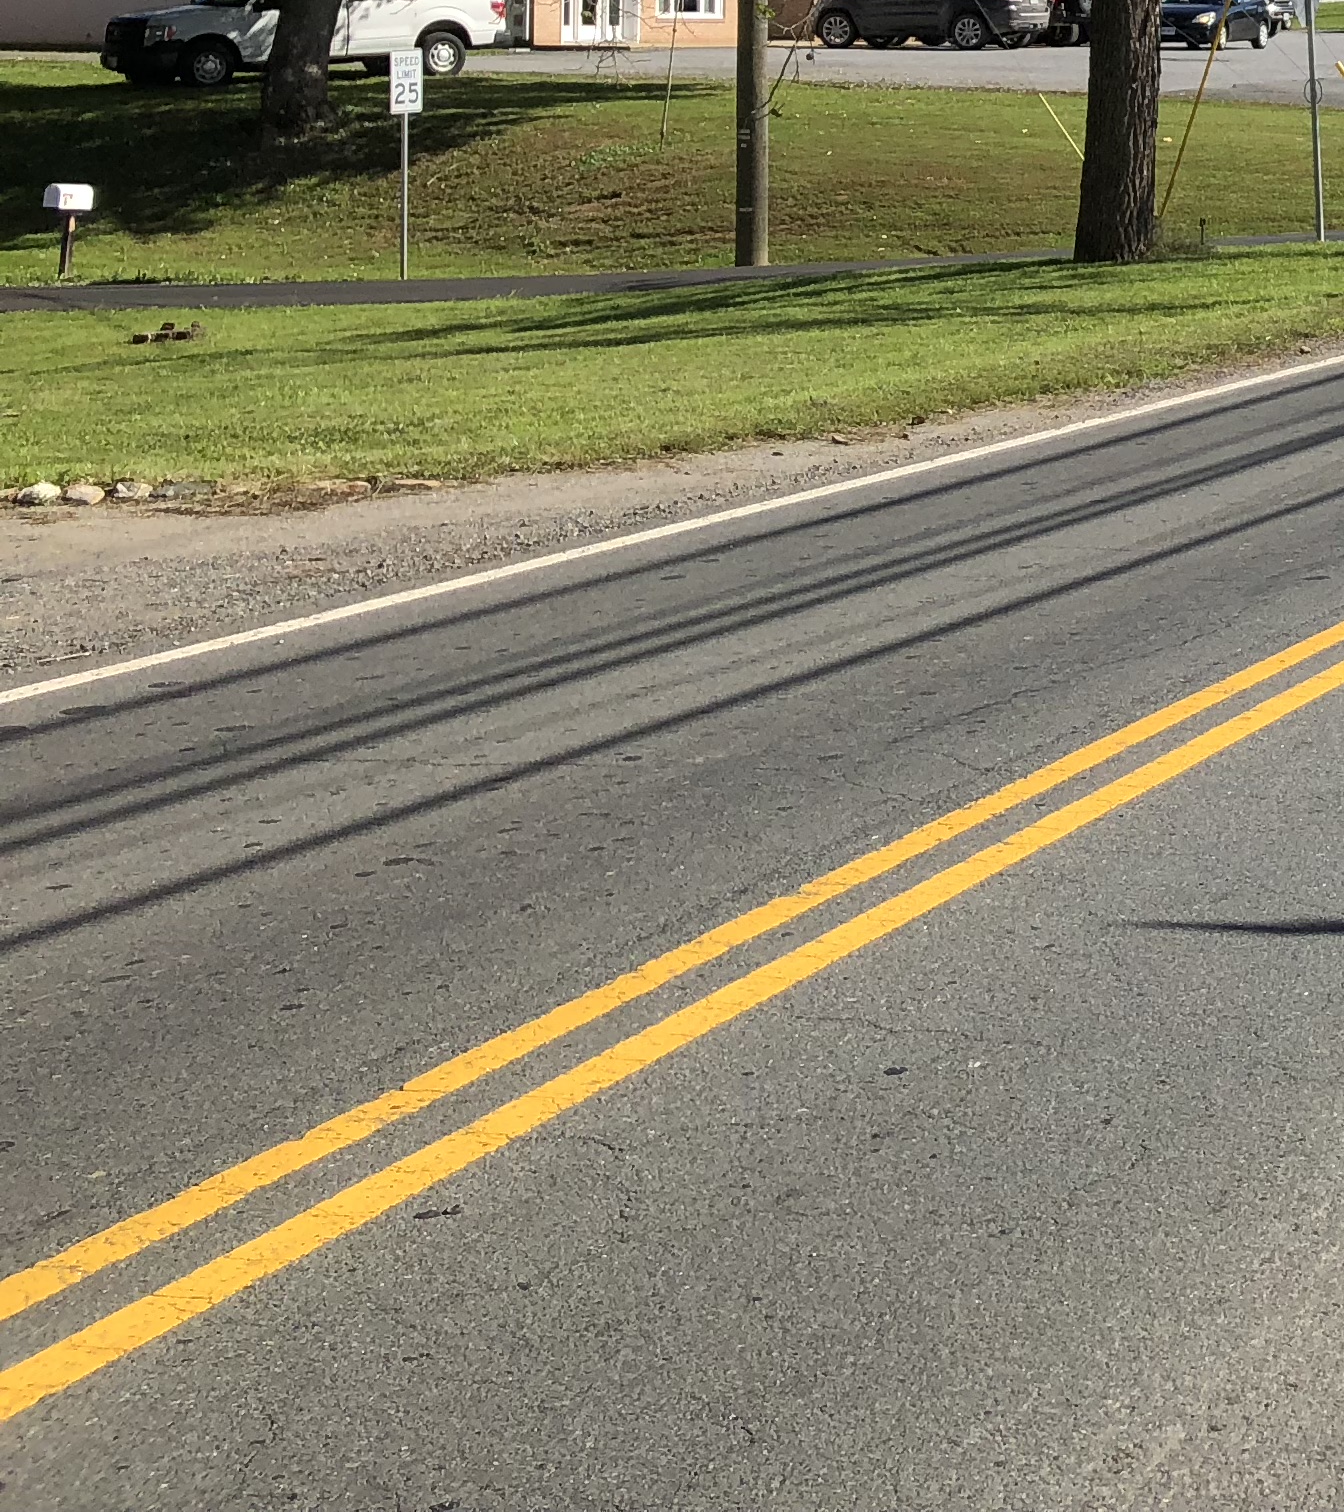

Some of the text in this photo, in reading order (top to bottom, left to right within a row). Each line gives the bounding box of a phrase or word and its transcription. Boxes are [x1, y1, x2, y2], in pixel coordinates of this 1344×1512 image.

[394, 56, 420, 67] SPEED
[396, 69, 417, 79] LIMIT
[394, 82, 419, 105] 25
